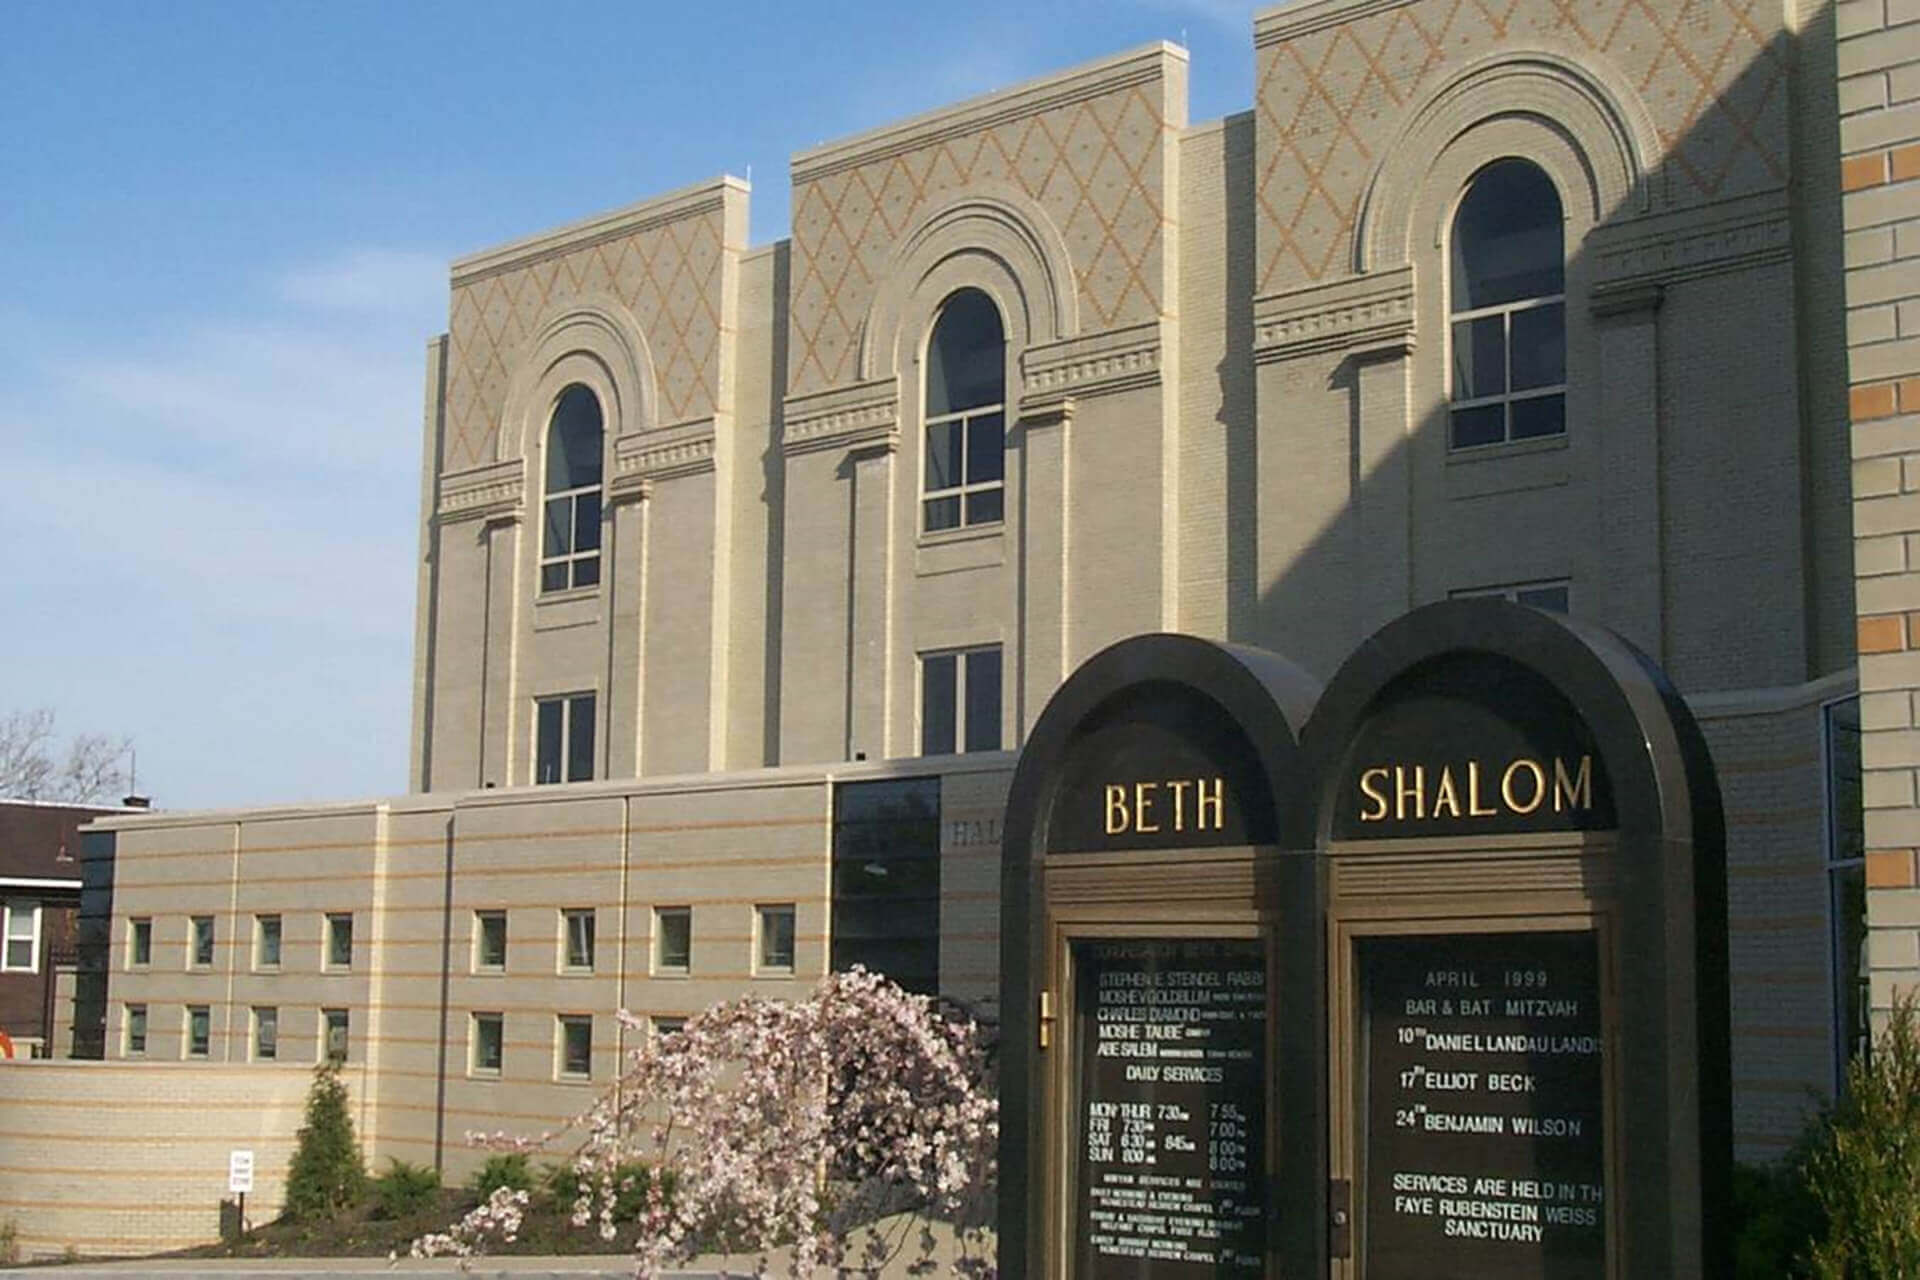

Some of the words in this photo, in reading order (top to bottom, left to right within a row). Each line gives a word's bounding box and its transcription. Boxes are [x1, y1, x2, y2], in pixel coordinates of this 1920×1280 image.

[1360, 755, 1593, 822] SHALOM
[1104, 776, 1226, 836] BETH
[1424, 970, 1480, 988] APRIL
[1503, 970, 1548, 988] 1999
[1405, 999, 1437, 1016] BAR
[1460, 1000, 1492, 1017] BAT
[1505, 1000, 1578, 1017] MITZVAH
[1099, 1023, 1140, 1039] MOSHE
[1426, 1033, 1485, 1051] DANIEL
[1487, 1034, 1548, 1053] LANDAU
[1126, 1065, 1161, 1081] DAILY
[1163, 1066, 1223, 1083] SERVICES
[1425, 1072, 1479, 1090] ELLIOT
[1488, 1074, 1537, 1093] BECK
[1424, 1113, 1504, 1134] BENJAMIN
[1511, 1117, 1582, 1137] WILSON
[1393, 1173, 1468, 1194] SERVICES
[1473, 1178, 1507, 1197] ARE
[1512, 1180, 1554, 1199] HELD
[1559, 1184, 1577, 1200] IN
[1395, 1196, 1434, 1215] FAYE
[1439, 1199, 1539, 1222] RUBENSTEIN
[1545, 1206, 1597, 1226] WEISS
[1444, 1219, 1544, 1242] SANCTUARY
